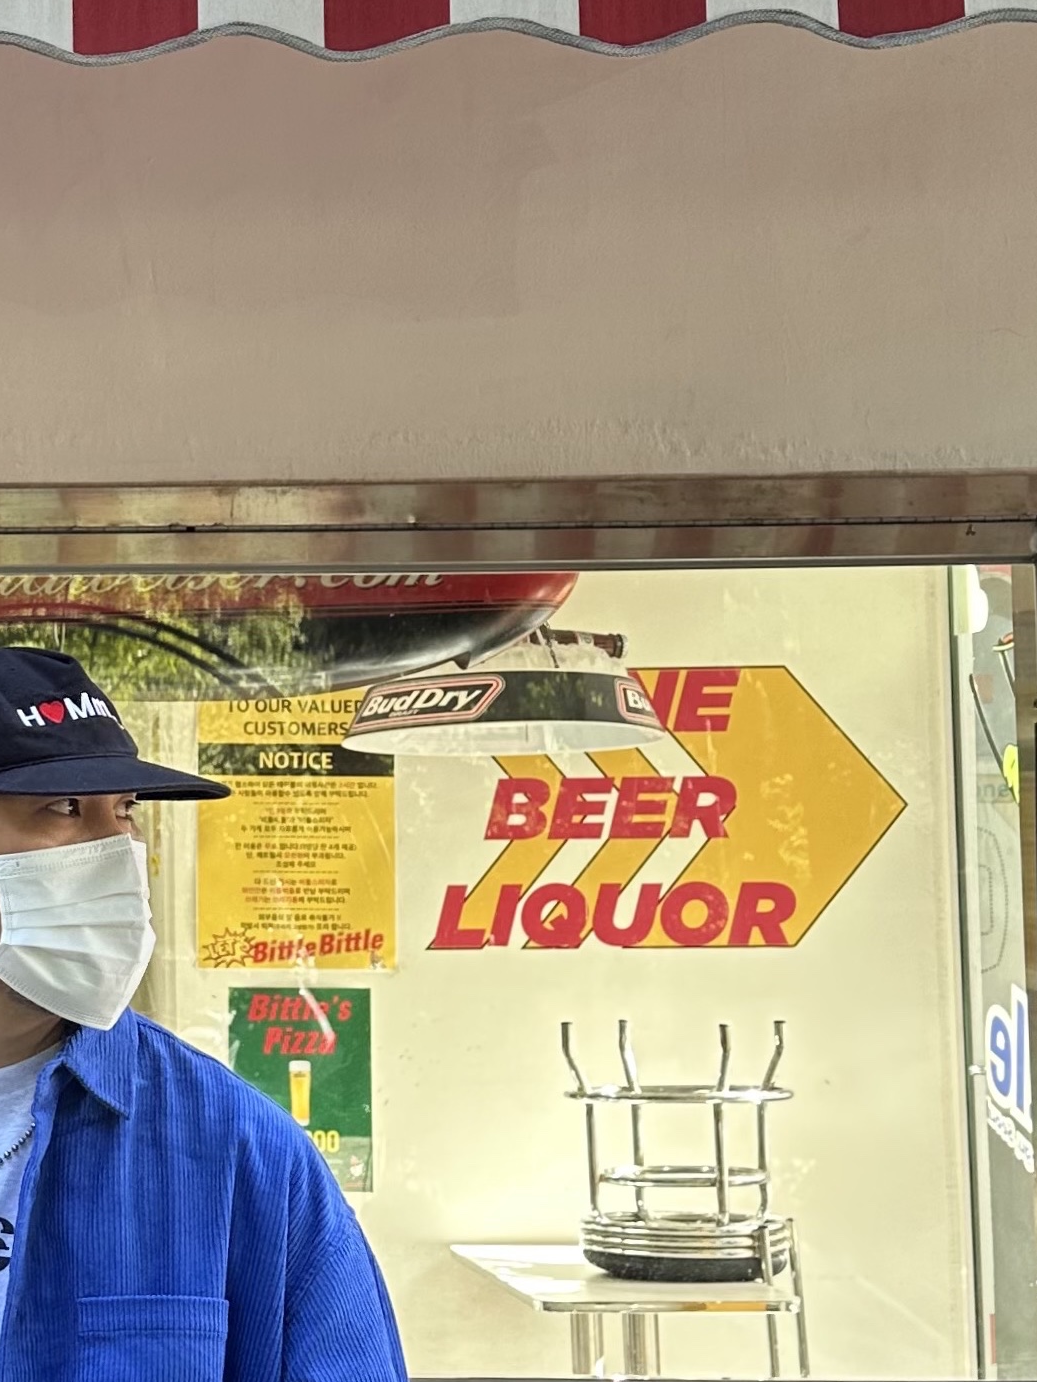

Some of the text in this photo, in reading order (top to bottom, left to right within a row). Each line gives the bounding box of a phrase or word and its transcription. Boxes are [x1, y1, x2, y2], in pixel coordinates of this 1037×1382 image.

[228, 700, 249, 713] TO
[255, 700, 292, 713] OUR
[244, 722, 348, 736] CUSTOMERS
[260, 752, 334, 769] NOTICE
[484, 776, 738, 840] BEER
[431, 881, 797, 948] LIQUOR
[262, 1027, 337, 1056] Pizza
